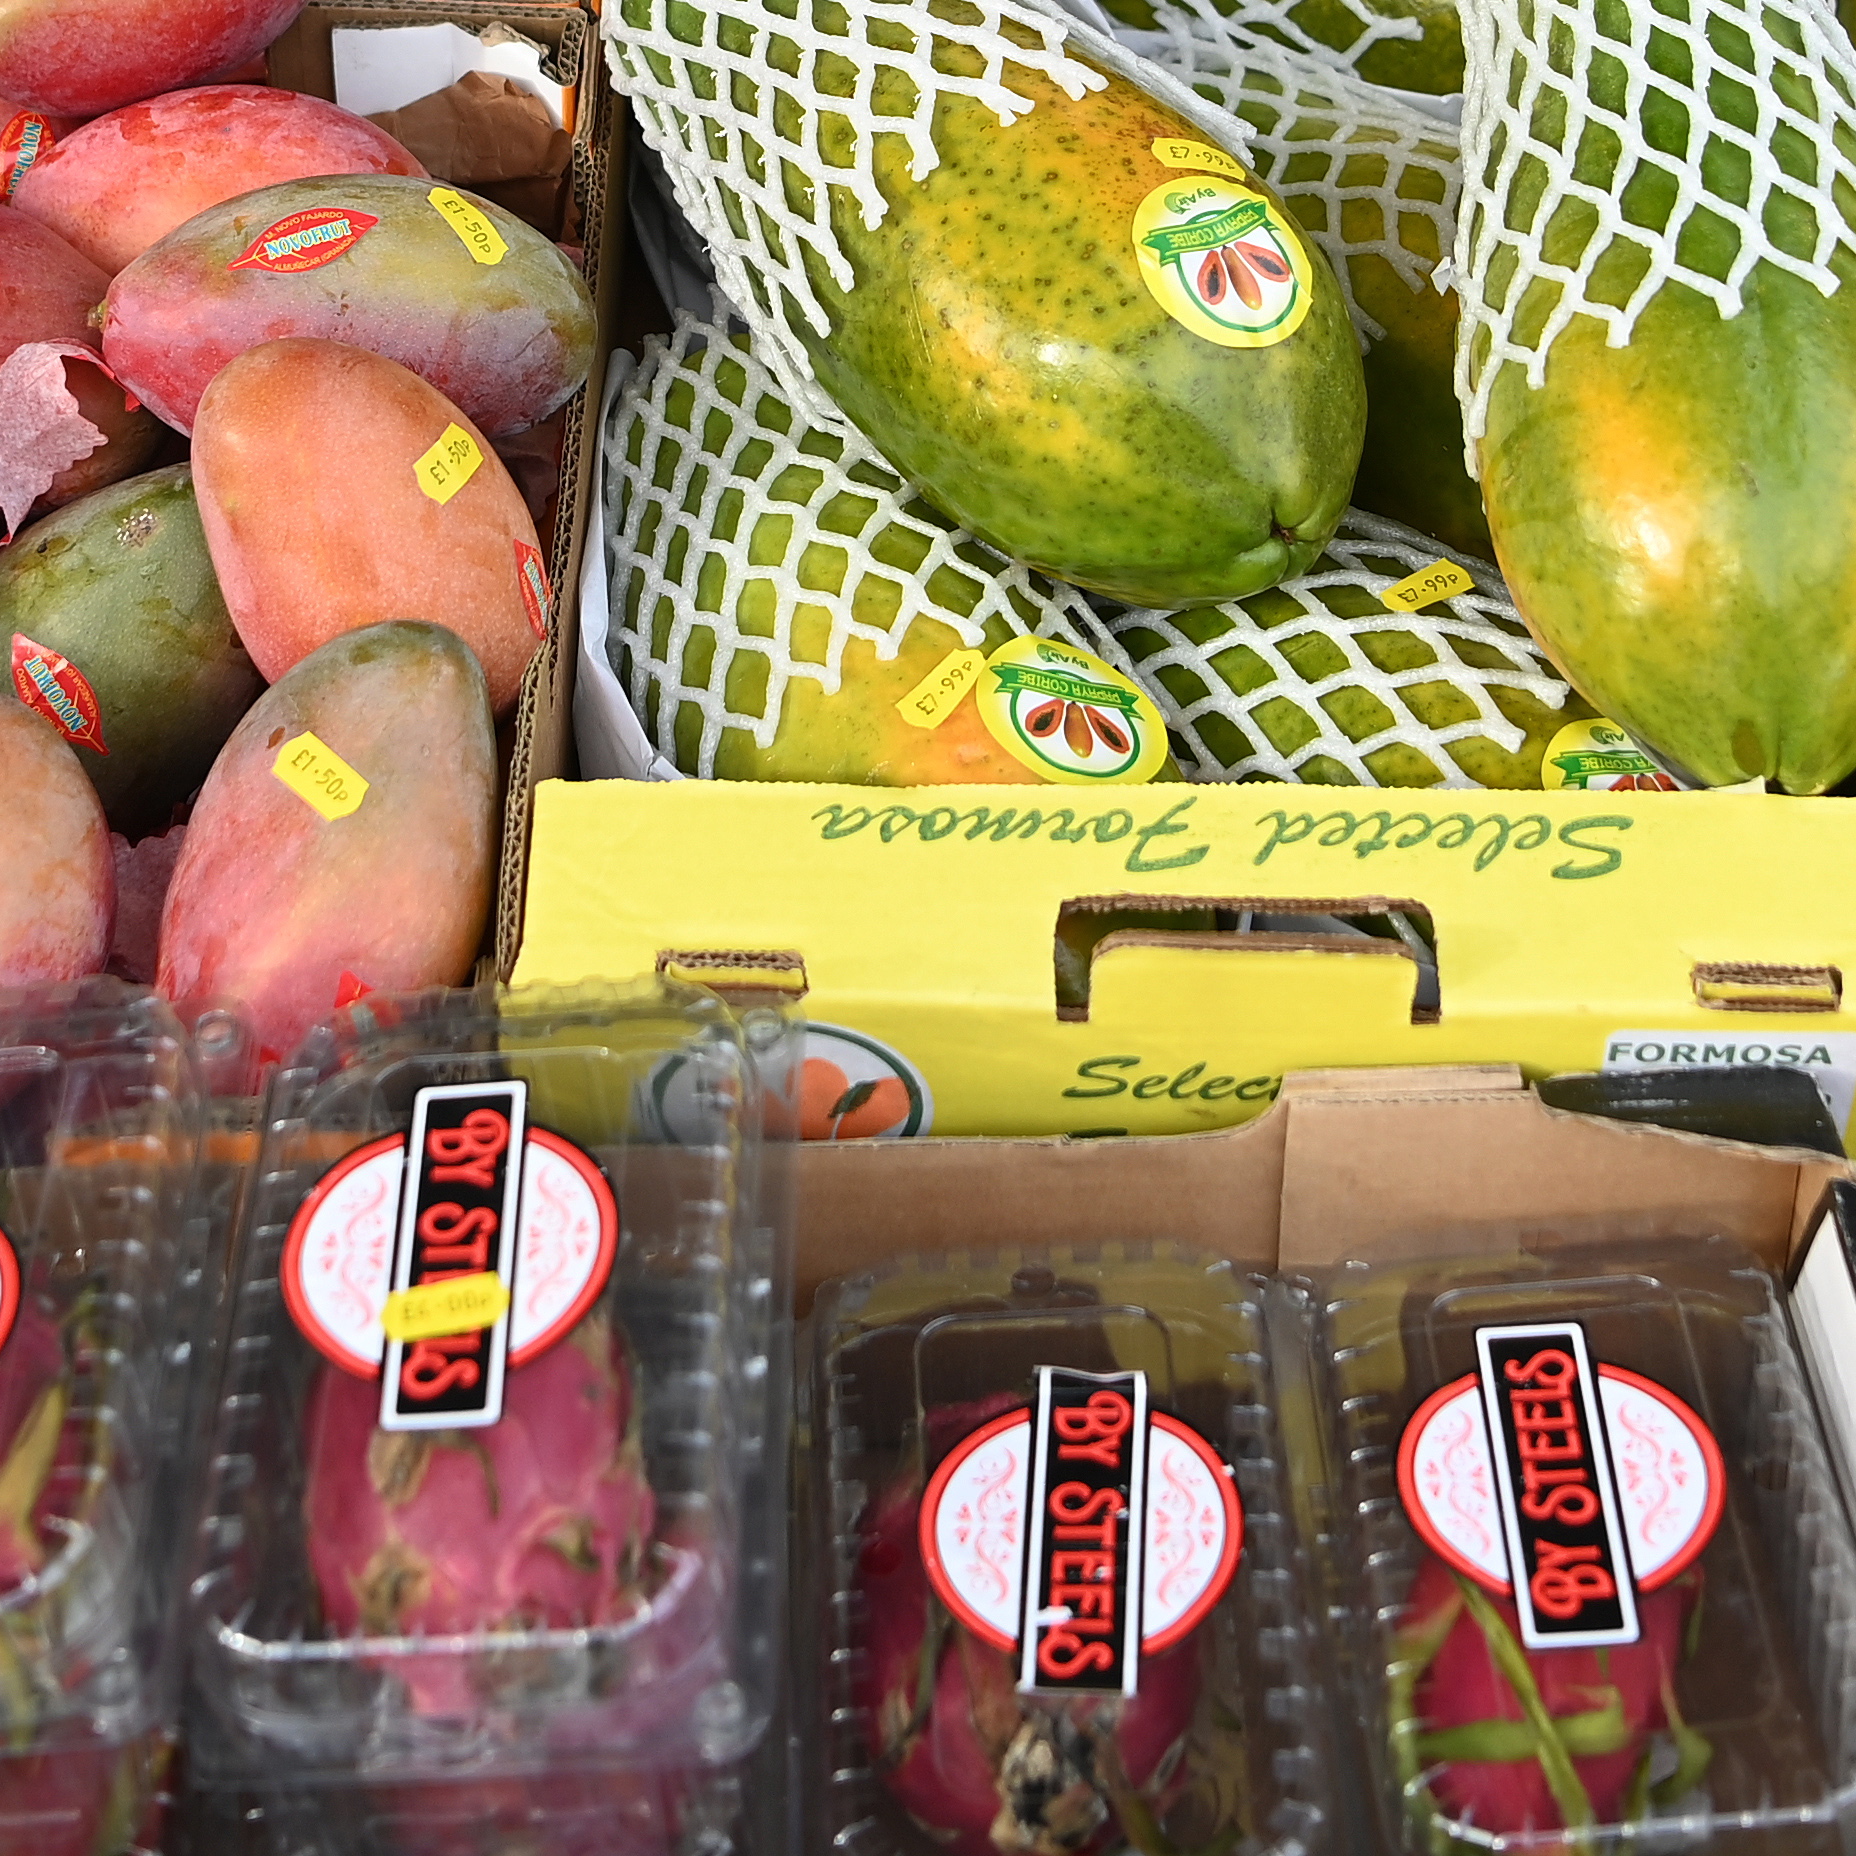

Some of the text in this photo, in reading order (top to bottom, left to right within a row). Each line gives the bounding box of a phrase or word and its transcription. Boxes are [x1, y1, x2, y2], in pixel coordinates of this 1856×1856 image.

[262, 217, 354, 261] NOVOFRUT
[23, 655, 90, 733] NOVOFRUT
[811, 798, 1635, 881] Selected Formosa
[1061, 1054, 1281, 1102] Selec
[1607, 1041, 1832, 1065] FORMOSA
[427, 1107, 509, 1189] BY
[1503, 1347, 1612, 1620] STEELS BY
[1039, 1390, 1133, 1680] BY STEELS
